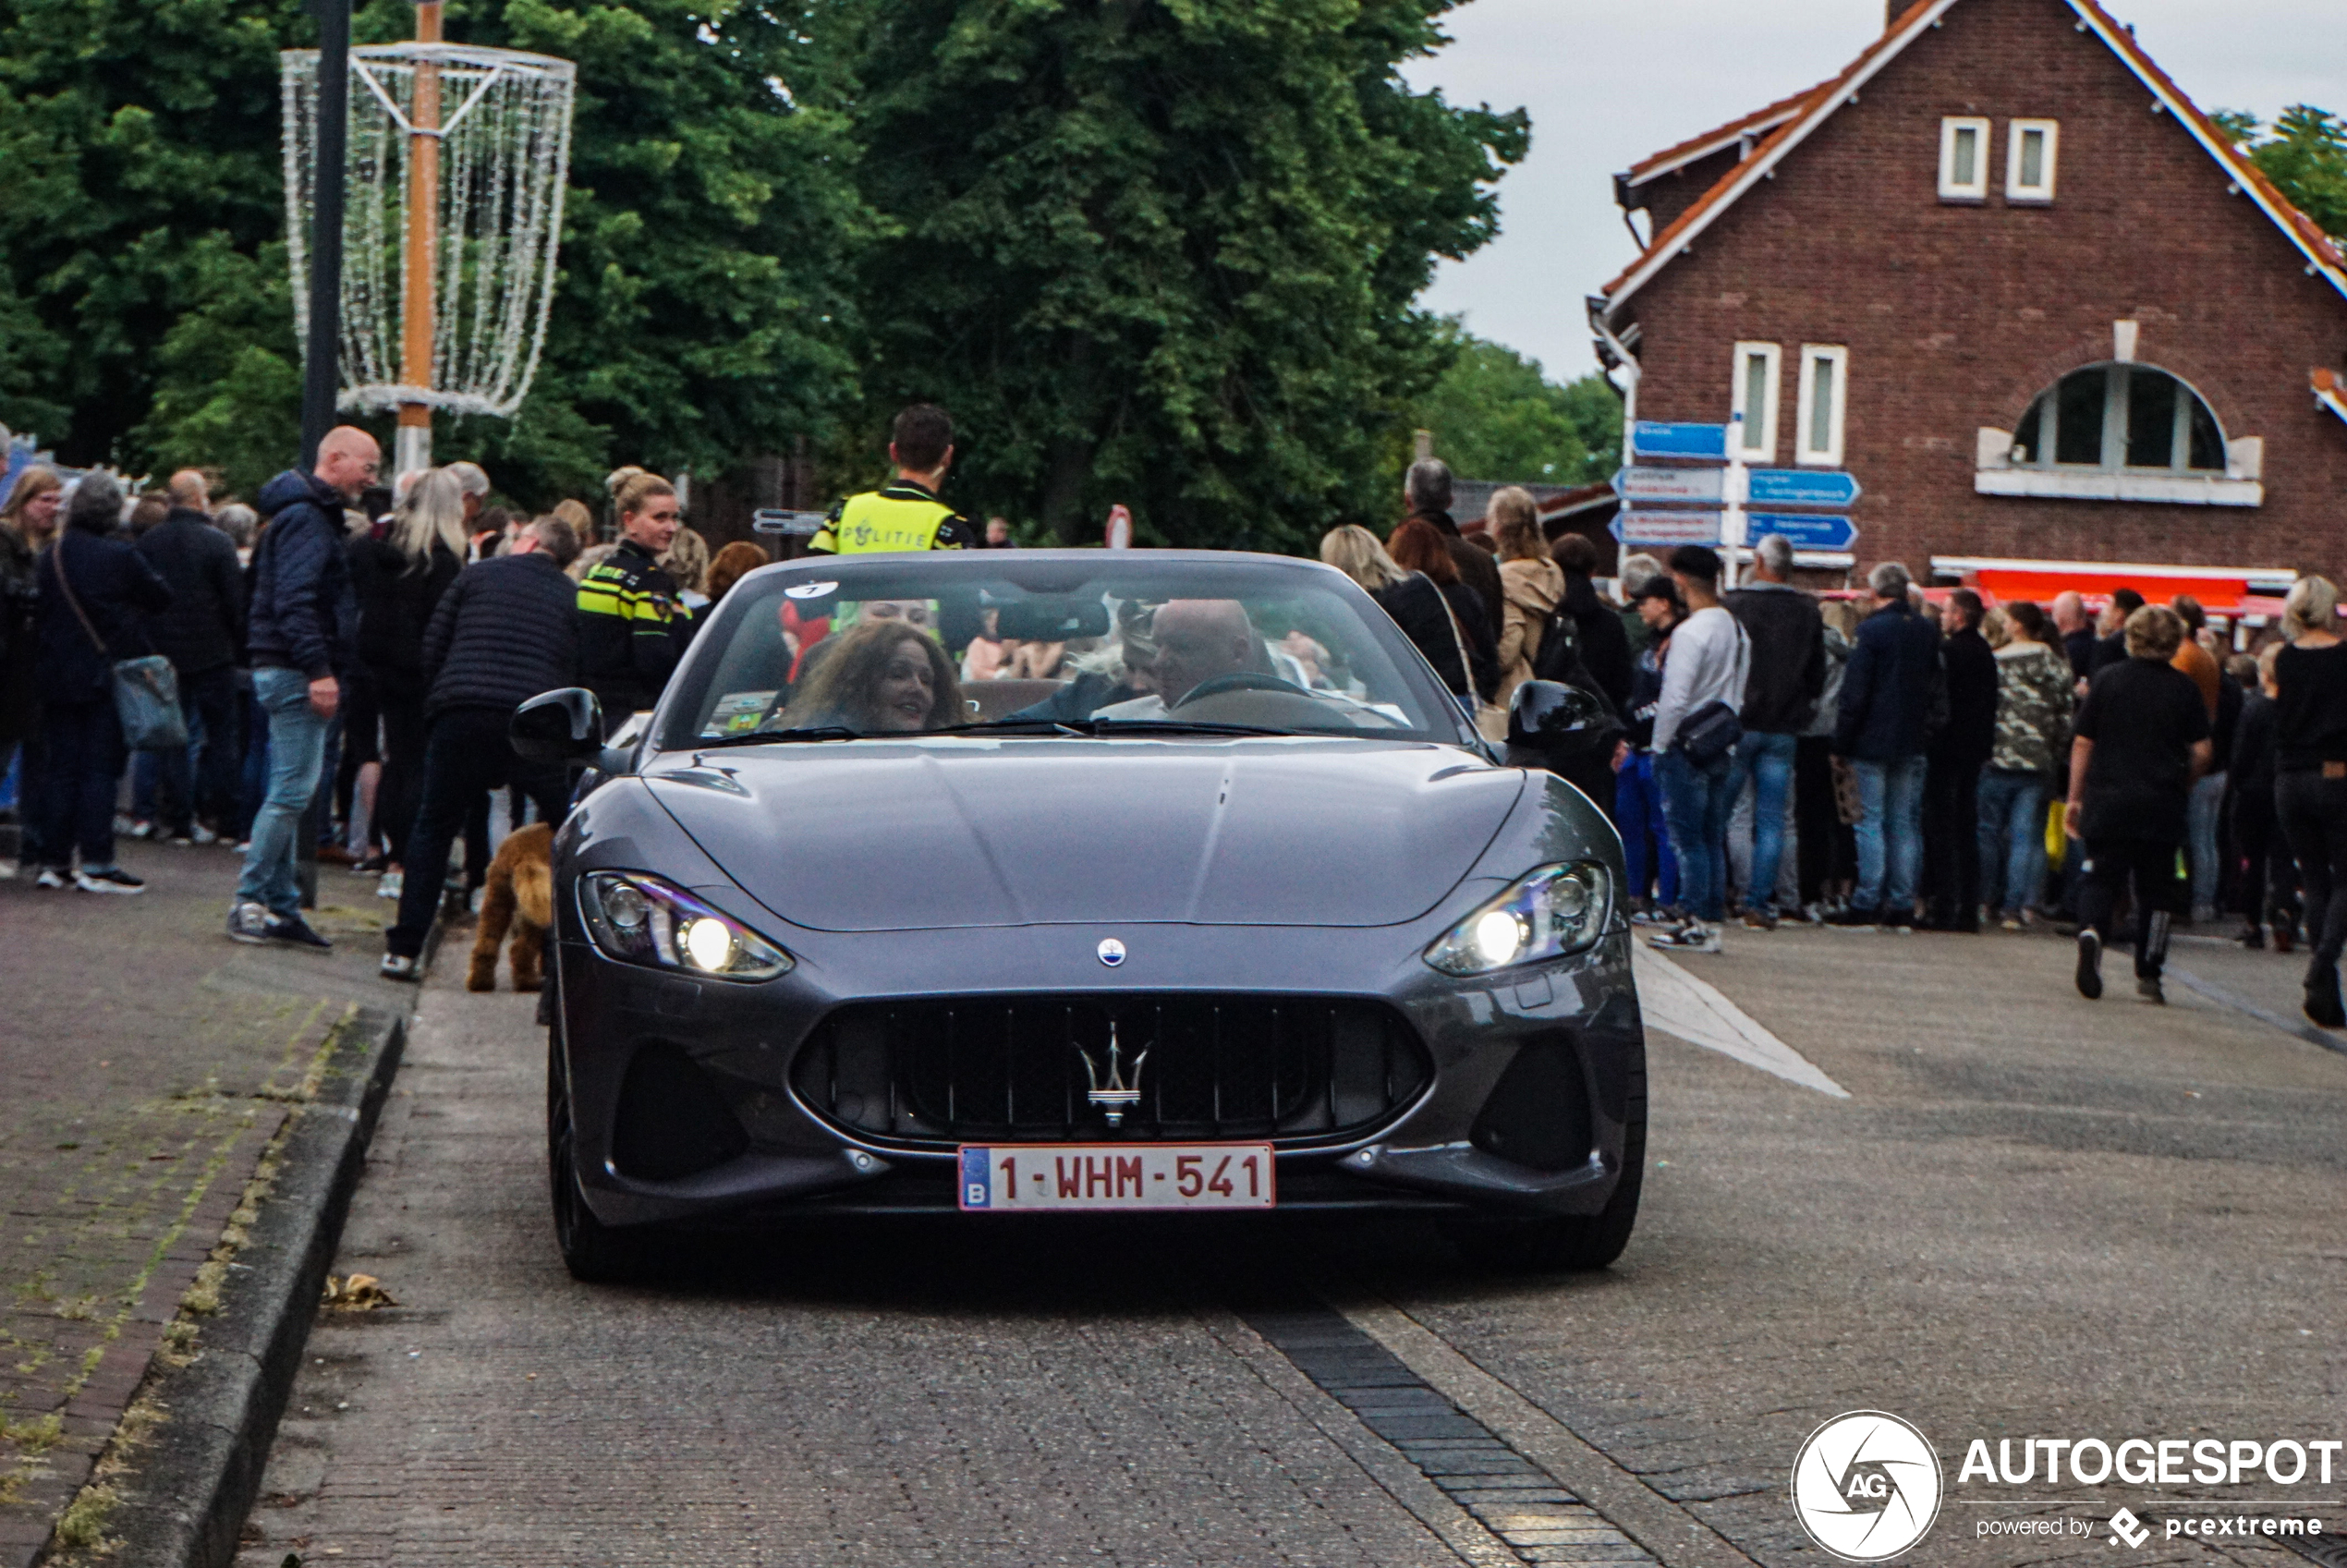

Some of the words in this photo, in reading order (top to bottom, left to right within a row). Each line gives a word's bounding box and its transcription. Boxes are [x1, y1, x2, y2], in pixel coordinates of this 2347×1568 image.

[842, 524, 926, 547] POLITIE
[1000, 1155, 1259, 1198] 1-WHM-541
[968, 1184, 986, 1203] B
